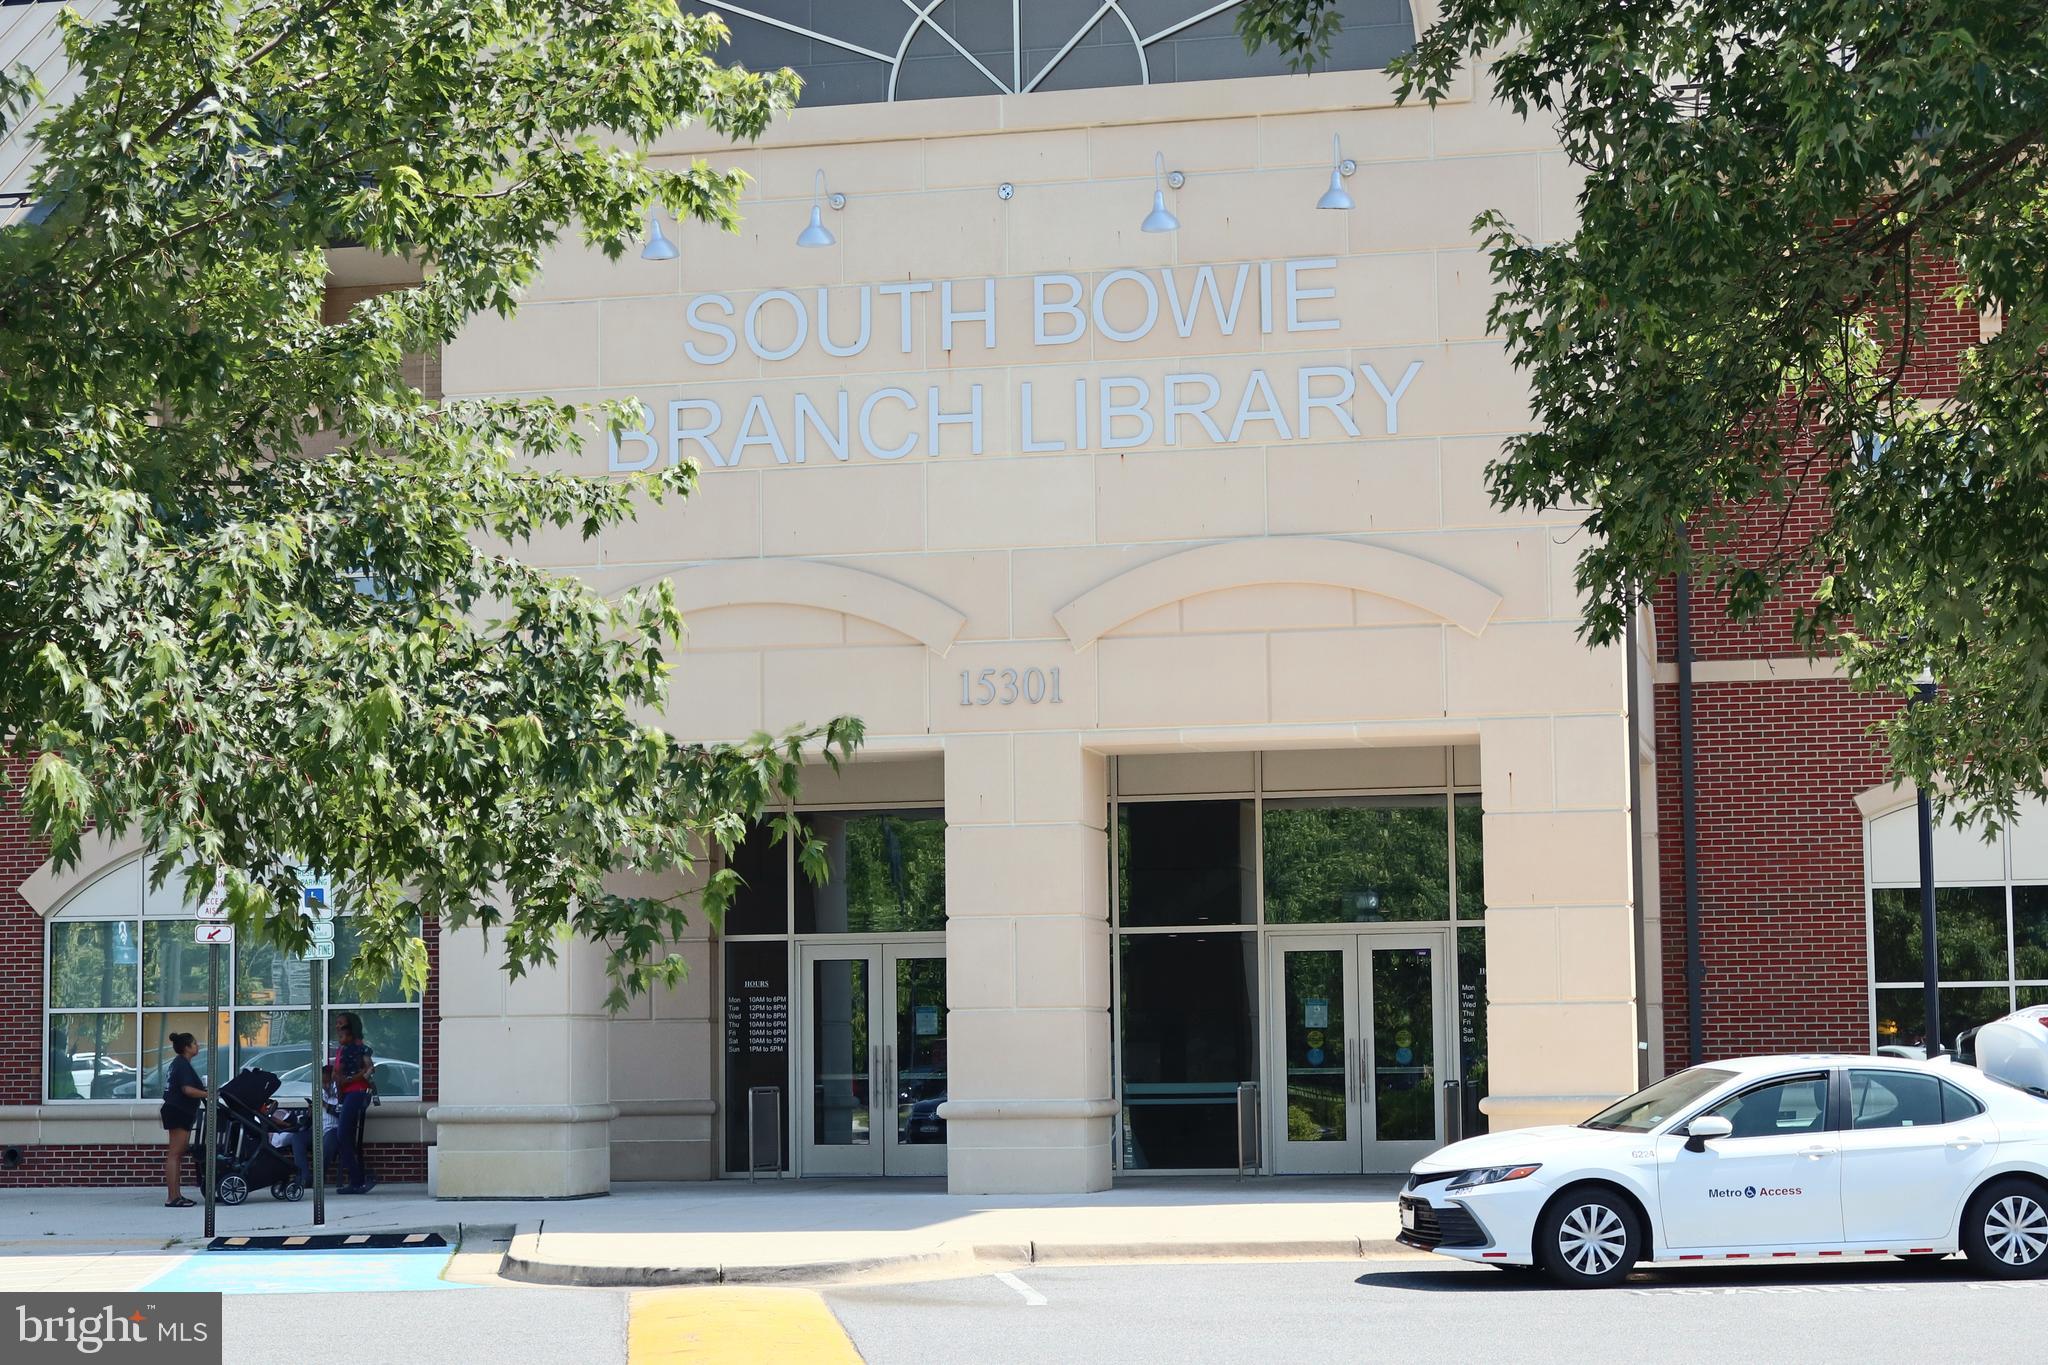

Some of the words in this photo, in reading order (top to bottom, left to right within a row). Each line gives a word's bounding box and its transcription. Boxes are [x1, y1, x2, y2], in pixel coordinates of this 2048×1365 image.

[683, 278, 997, 366] SOUTH
[1033, 258, 1341, 347] BOWIE
[607, 383, 983, 473] BRANCH
[1020, 360, 1424, 454] LIBRARY
[960, 667, 1064, 705] 15301
[205, 907, 225, 915] AISE
[318, 944, 331, 955] FINE
[744, 980, 769, 988] HOURS
[1709, 1188, 1742, 1198] Metro
[1759, 1186, 1802, 1197] Access
